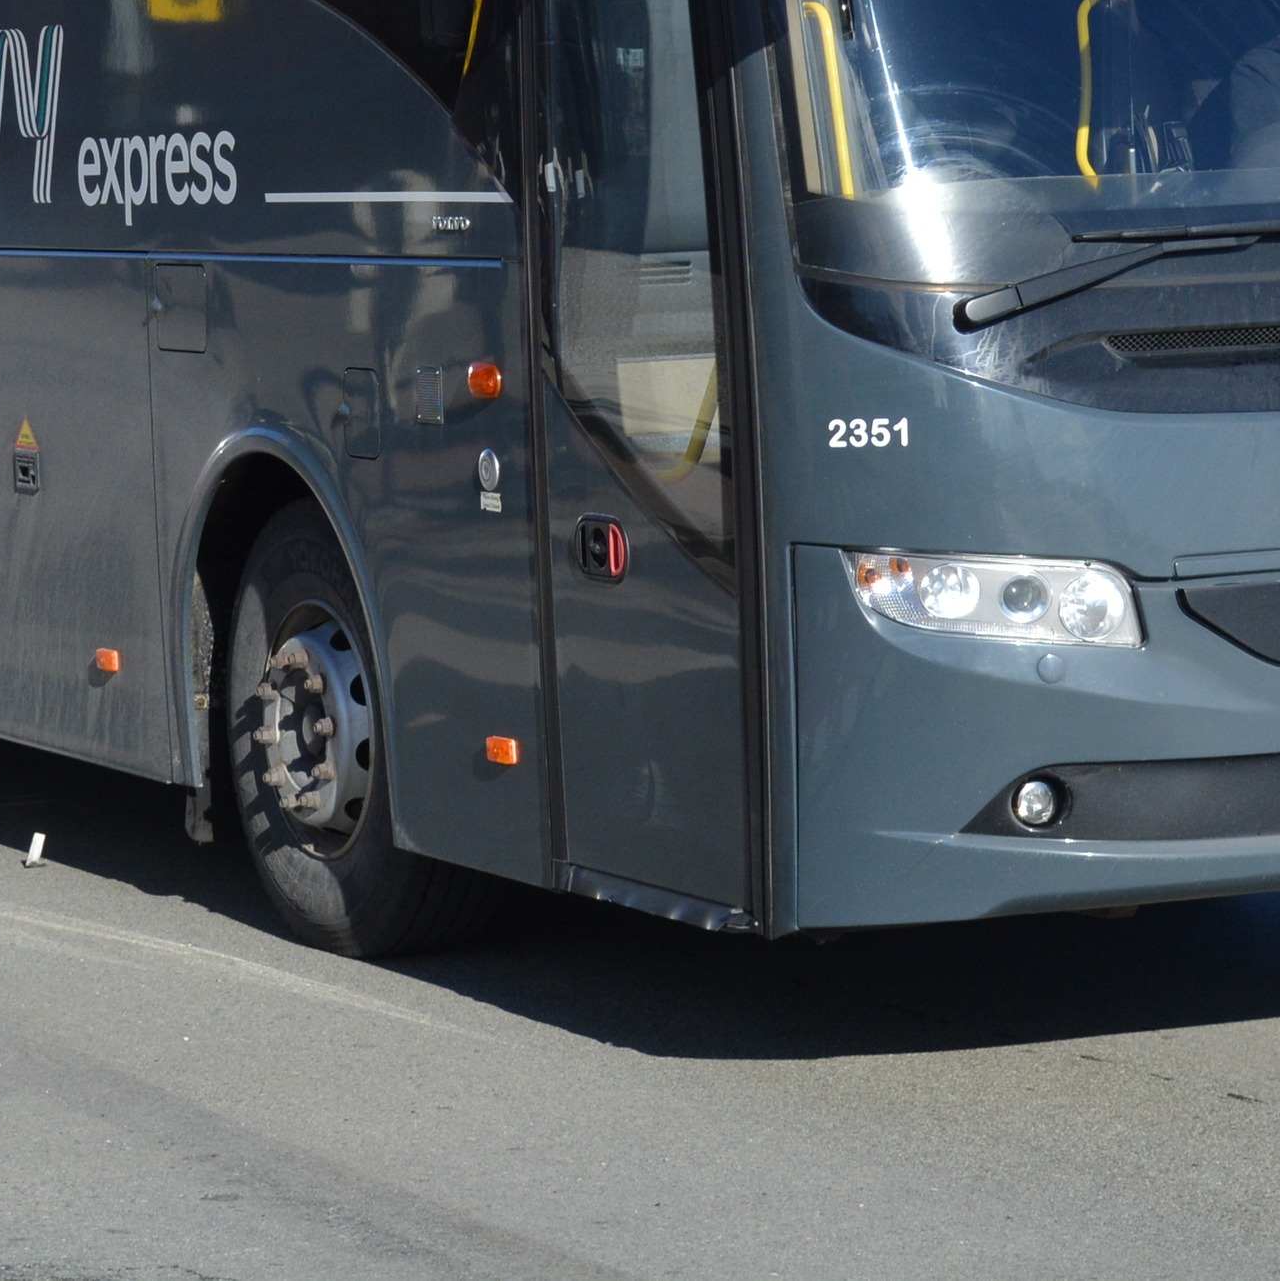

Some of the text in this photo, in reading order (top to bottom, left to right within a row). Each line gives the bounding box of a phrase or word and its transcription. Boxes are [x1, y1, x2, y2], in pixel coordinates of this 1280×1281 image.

[77, 130, 238, 226] express
[432, 216, 470, 230] VOLVO
[828, 417, 909, 448] 2351
